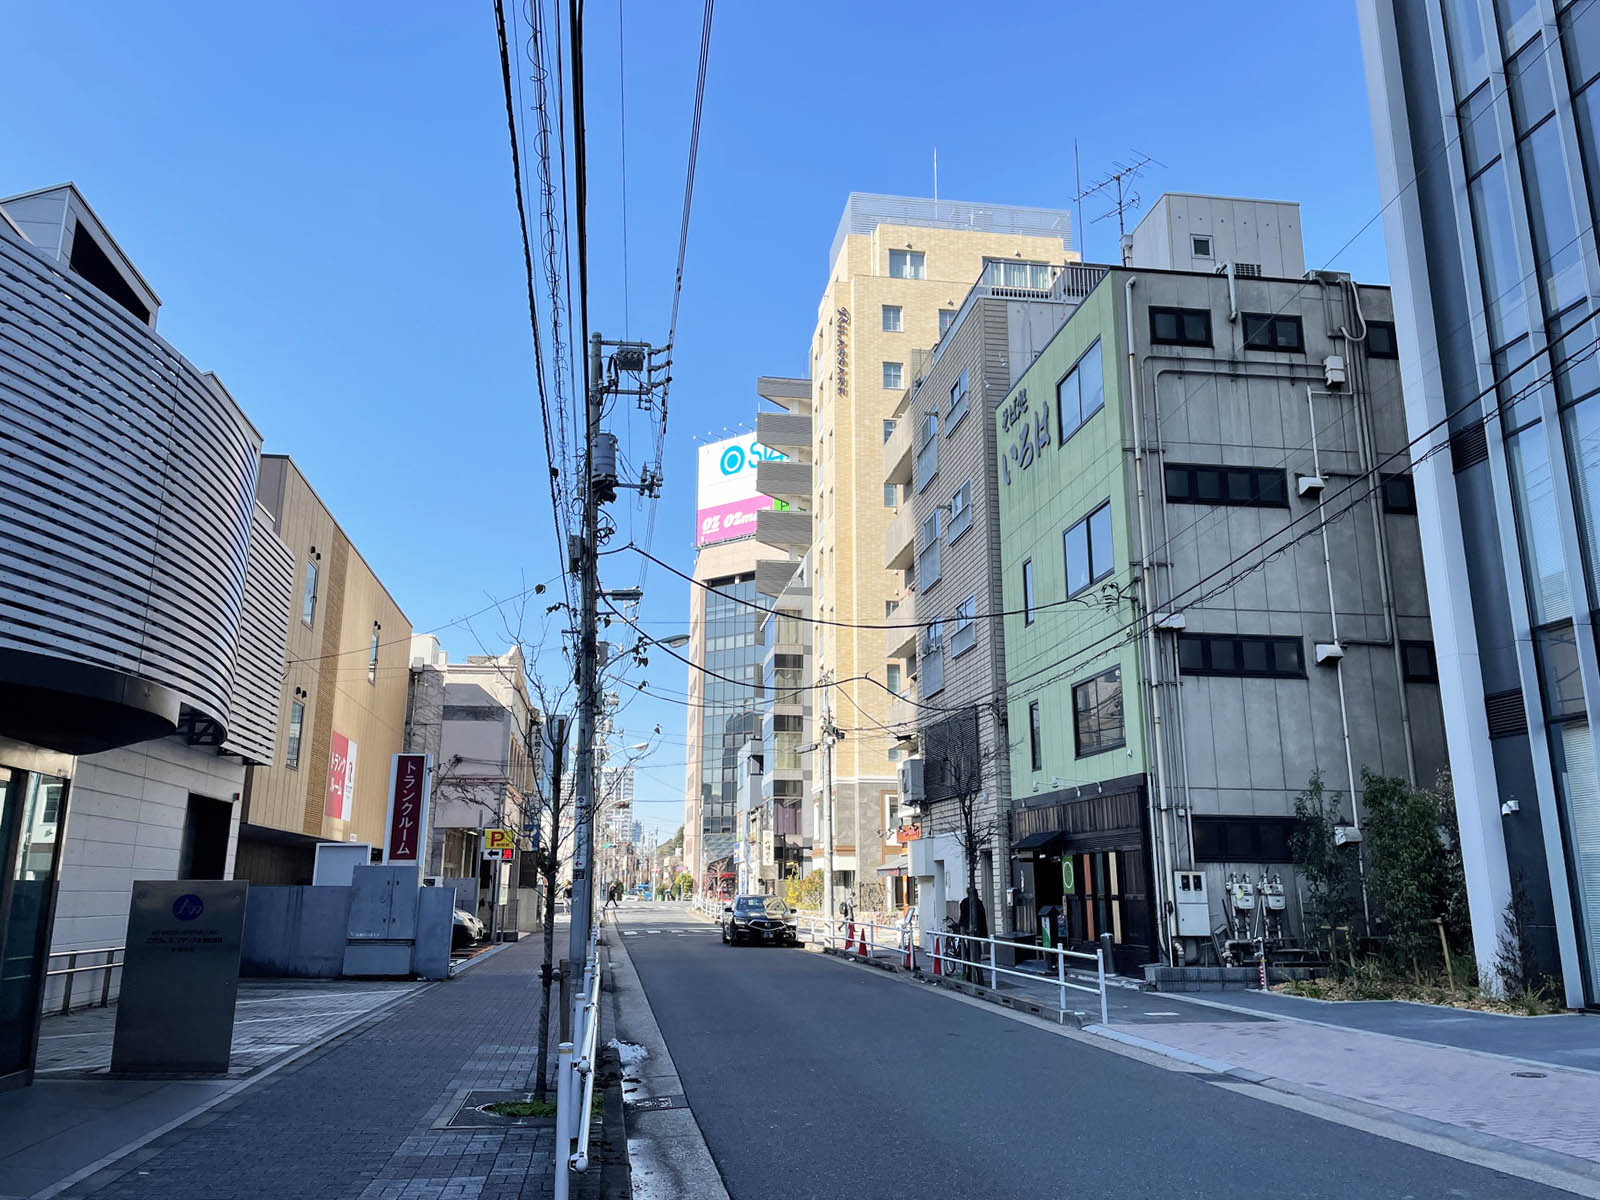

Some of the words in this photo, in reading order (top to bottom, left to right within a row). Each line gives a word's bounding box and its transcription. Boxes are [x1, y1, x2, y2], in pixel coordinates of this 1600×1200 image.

[1001, 400, 1051, 486] いろは
[330, 751, 346, 774] トランク
[329, 777, 342, 796] ルーム
[396, 760, 416, 854] トランクルーム
[490, 831, 505, 848] P
